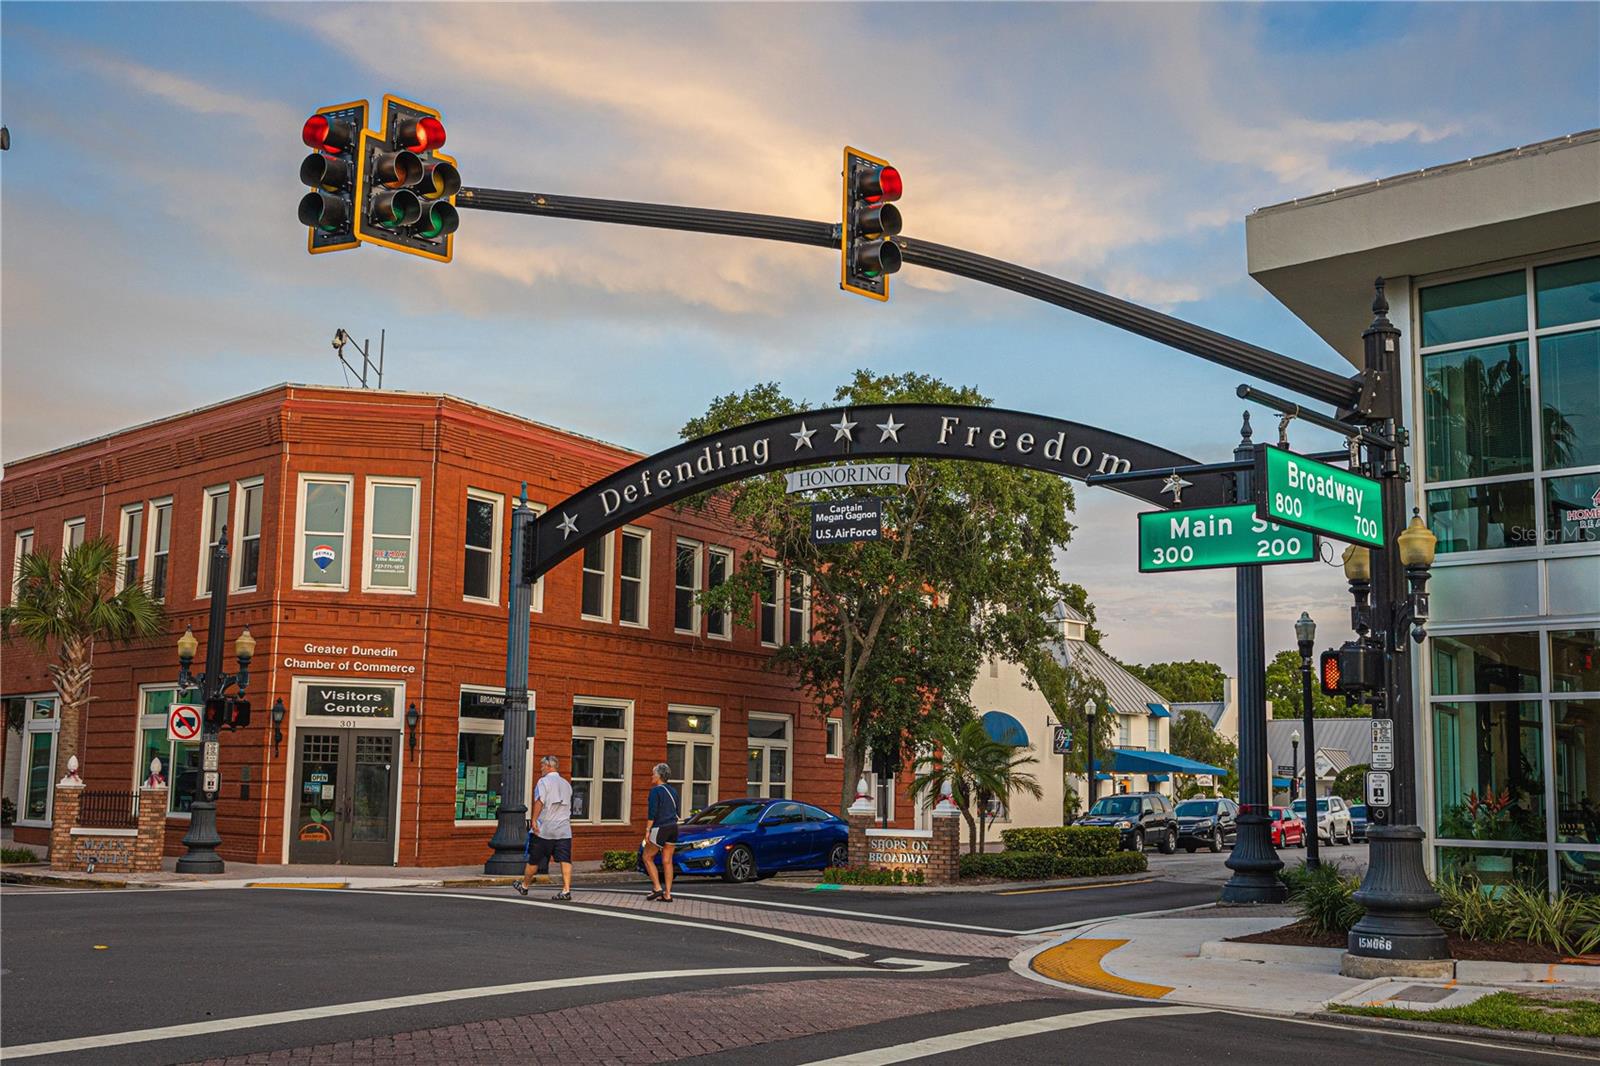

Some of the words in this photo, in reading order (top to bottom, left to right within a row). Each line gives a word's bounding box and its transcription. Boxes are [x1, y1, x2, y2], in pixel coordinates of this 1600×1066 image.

[599, 437, 770, 517] Defending
[937, 416, 1132, 475] Freedom
[800, 466, 891, 487] HONORING
[1288, 460, 1363, 513] Broadway
[829, 503, 863, 514] Captain
[815, 513, 844, 522] Megan
[845, 511, 877, 521] Gagnon
[1275, 492, 1302, 518] 800
[1354, 515, 1377, 539] 700
[815, 528, 834, 539] U.S.
[1170, 514, 1233, 540] Main
[1152, 545, 1194, 565] 300
[1257, 537, 1301, 557] 200
[304, 643, 348, 655] Greater
[352, 645, 398, 657] Dunedin
[284, 657, 335, 670] Chamber
[338, 660, 350, 671] of
[353, 661, 416, 673] Commerce
[320, 690, 382, 701] Visitors
[324, 702, 378, 713] Center
[340, 720, 357, 728] 301
[871, 840, 907, 850] SHOPS
[912, 841, 929, 851] ON
[869, 852, 931, 864] BROADWAY
